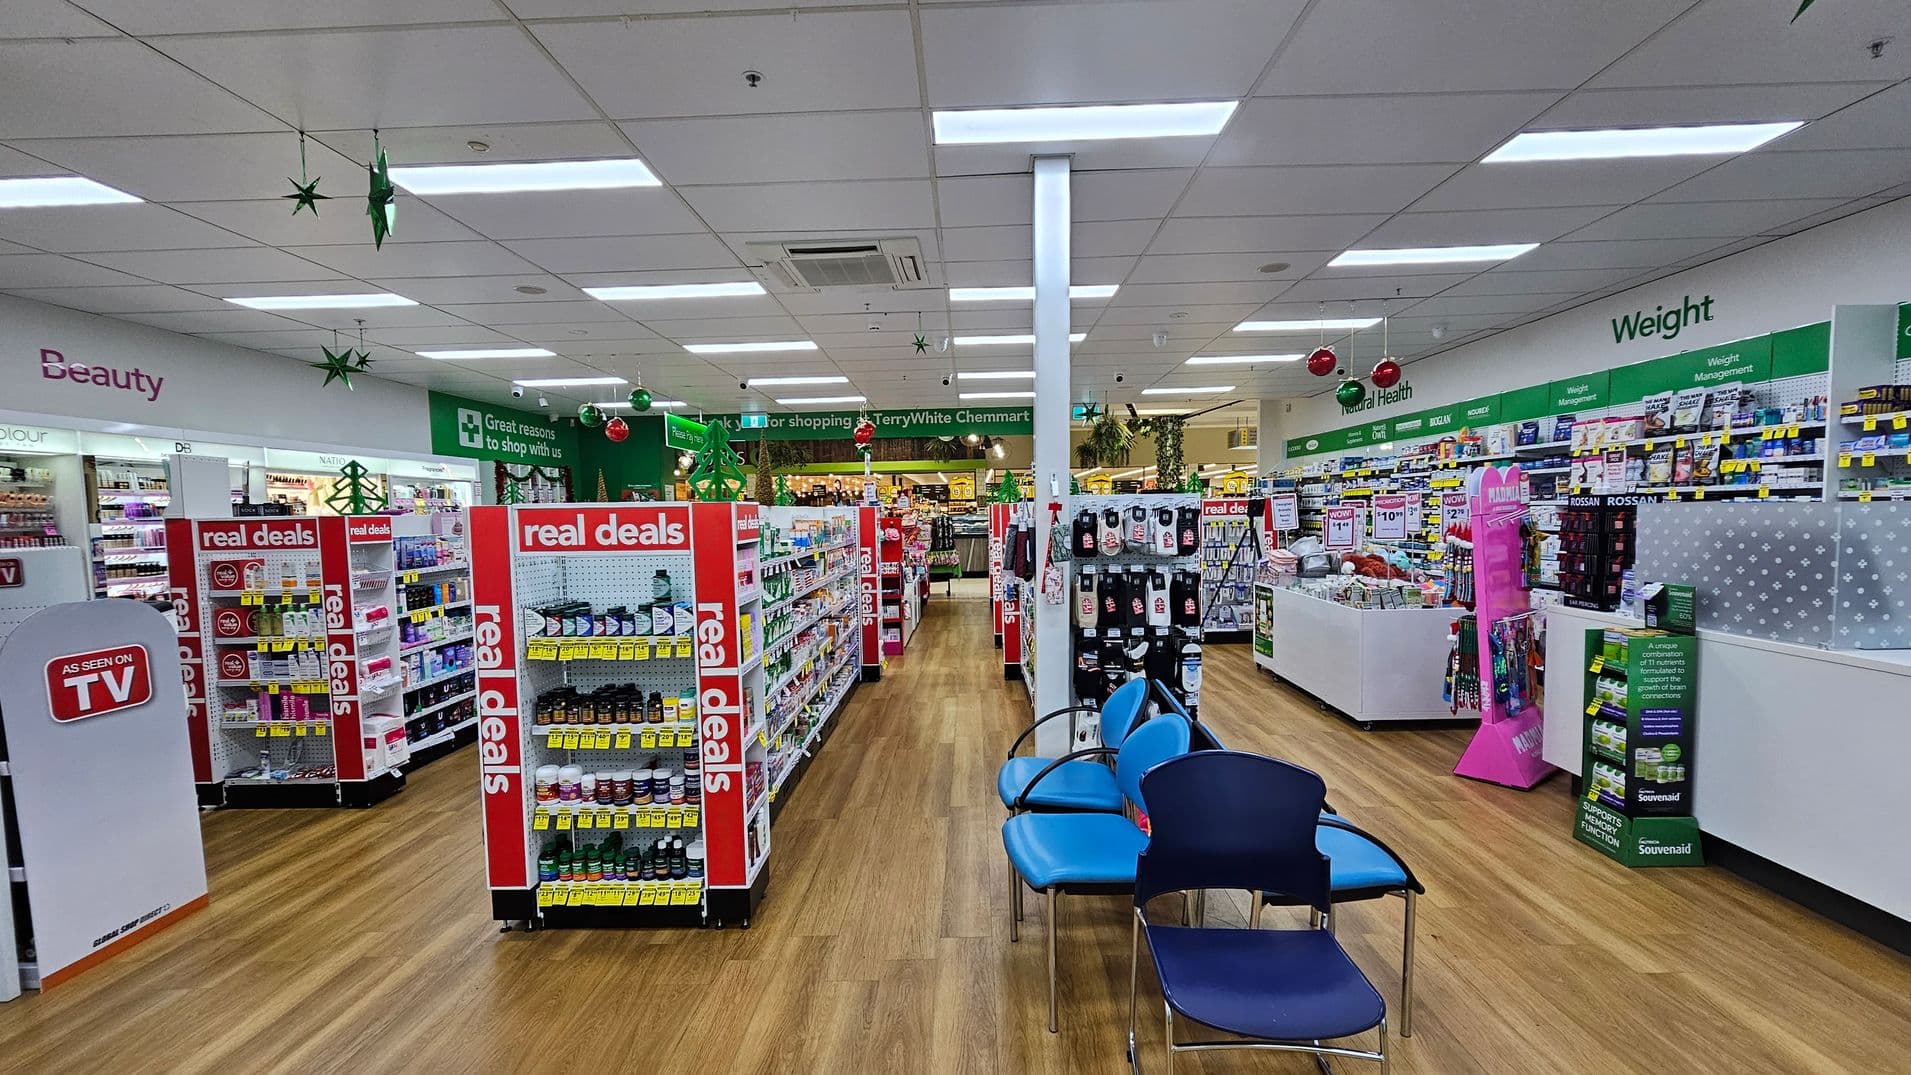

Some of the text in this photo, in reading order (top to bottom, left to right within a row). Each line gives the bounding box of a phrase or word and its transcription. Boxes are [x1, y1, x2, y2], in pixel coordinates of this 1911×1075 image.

[1611, 295, 1715, 344] Weight
[1707, 354, 1740, 366] Weight
[40, 348, 164, 402] Beauty
[1694, 365, 1754, 382] Management
[1377, 380, 1413, 407] Health
[1558, 394, 1597, 406] Management
[1566, 384, 1589, 394] Weight
[485, 413, 556, 441] Great reasons
[766, 415, 785, 427] for
[788, 414, 852, 430] shopping
[873, 411, 952, 428] TerryWhite
[955, 410, 1030, 424] Chemmart
[486, 434, 562, 459] to shop with us
[1204, 501, 1248, 514] real dea
[1570, 497, 1600, 506] ROSSAN
[1607, 495, 1658, 506] ROSSAN
[1329, 510, 1352, 519] WOW!
[203, 523, 315, 547] real deals
[350, 523, 391, 536] real deals
[524, 512, 685, 547] real deals
[861, 547, 878, 626] real deals
[1004, 601, 1020, 625] als
[171, 587, 206, 718] real deals
[325, 585, 359, 716] real deals
[1655, 642, 1679, 651] unique
[62, 653, 134, 676] AS SEEN ON
[63, 666, 136, 712] TV
[1638, 684, 1661, 692] growth
[1643, 676, 1671, 684] support
[475, 605, 521, 795] real deals
[698, 602, 742, 793] real deals
[1641, 692, 1682, 700] connections
[1638, 792, 1681, 802] Souvenaid
[1582, 801, 1623, 828] SUPPORTS
[1584, 812, 1618, 836] MEMORY
[1581, 820, 1620, 848] FUNCTION
[1638, 843, 1692, 855] Souvenaid
